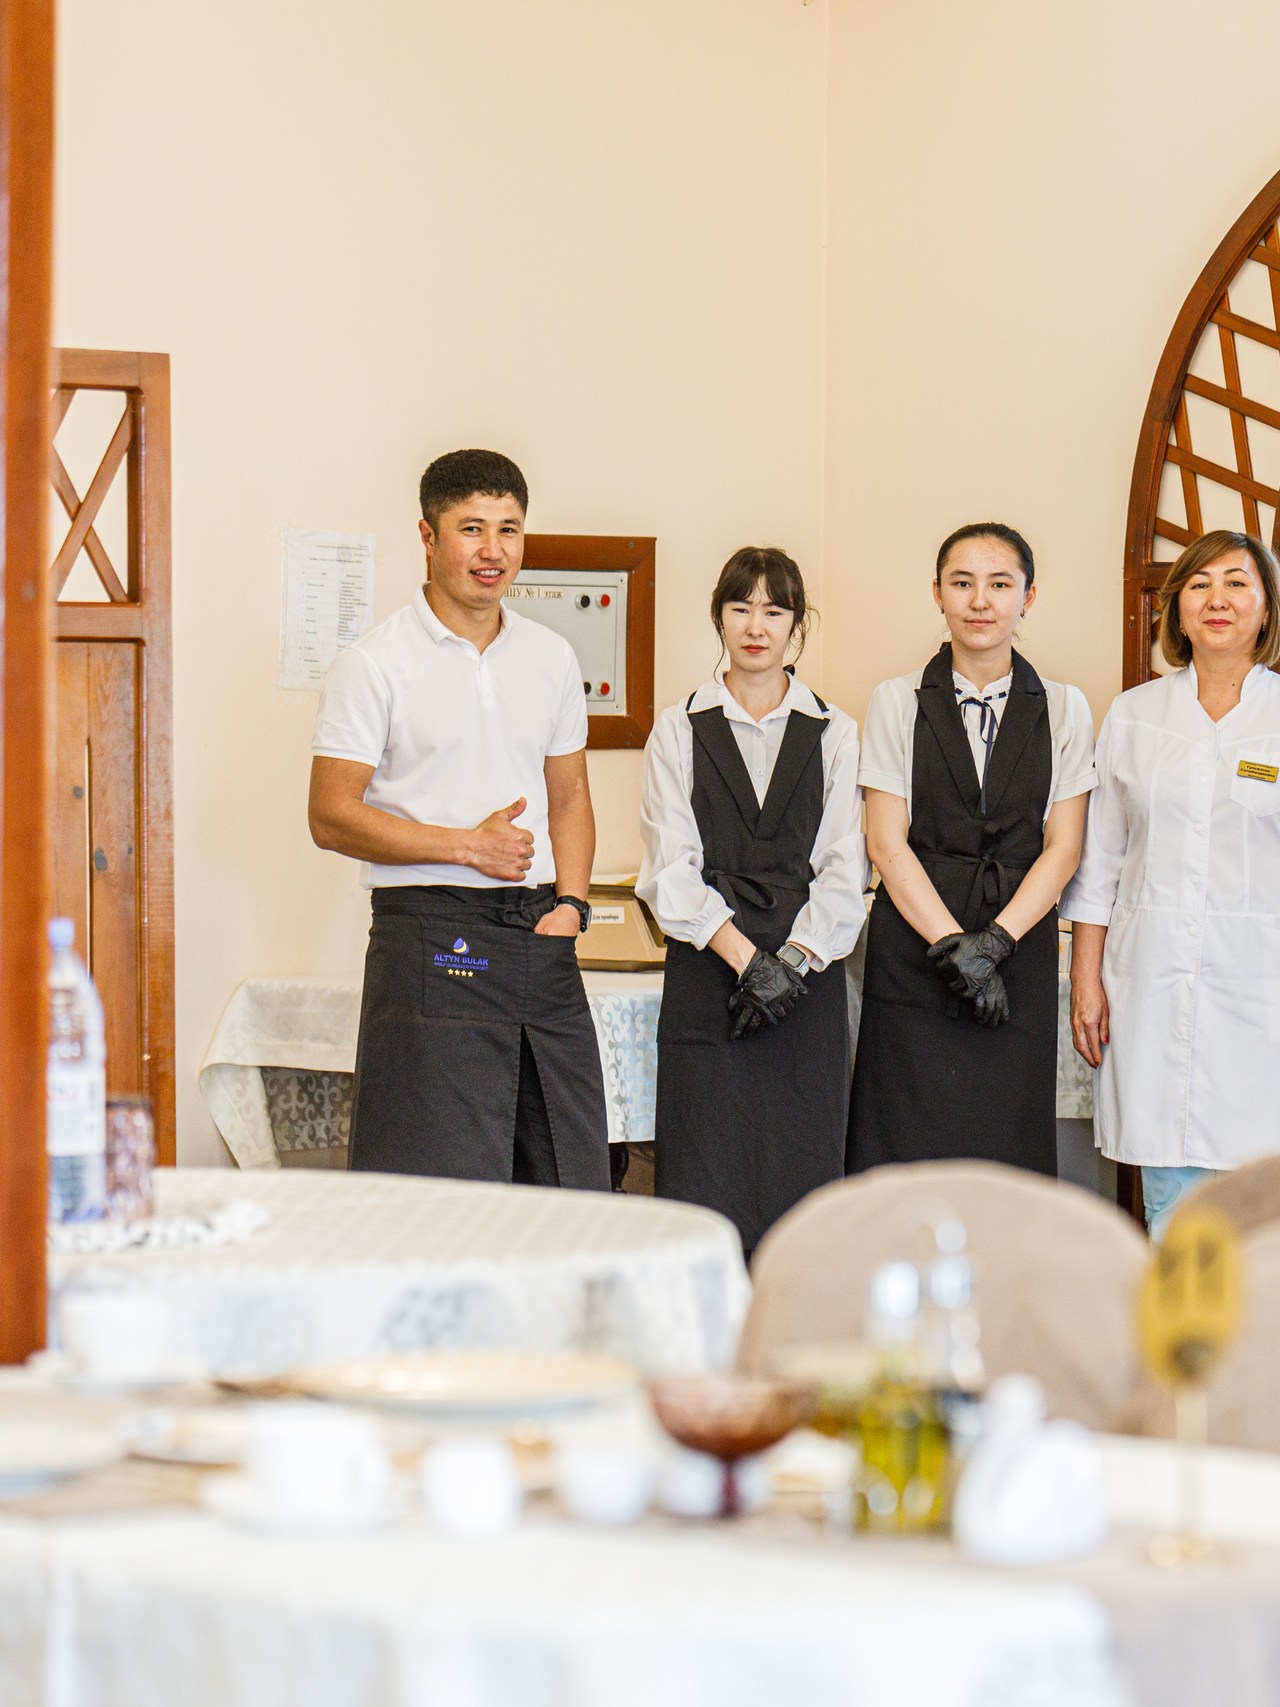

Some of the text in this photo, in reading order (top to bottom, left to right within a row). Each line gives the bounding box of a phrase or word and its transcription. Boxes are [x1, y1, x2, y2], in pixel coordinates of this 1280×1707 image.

[544, 591, 563, 599] этаж
[434, 953, 488, 966] ALTYN BULAK
